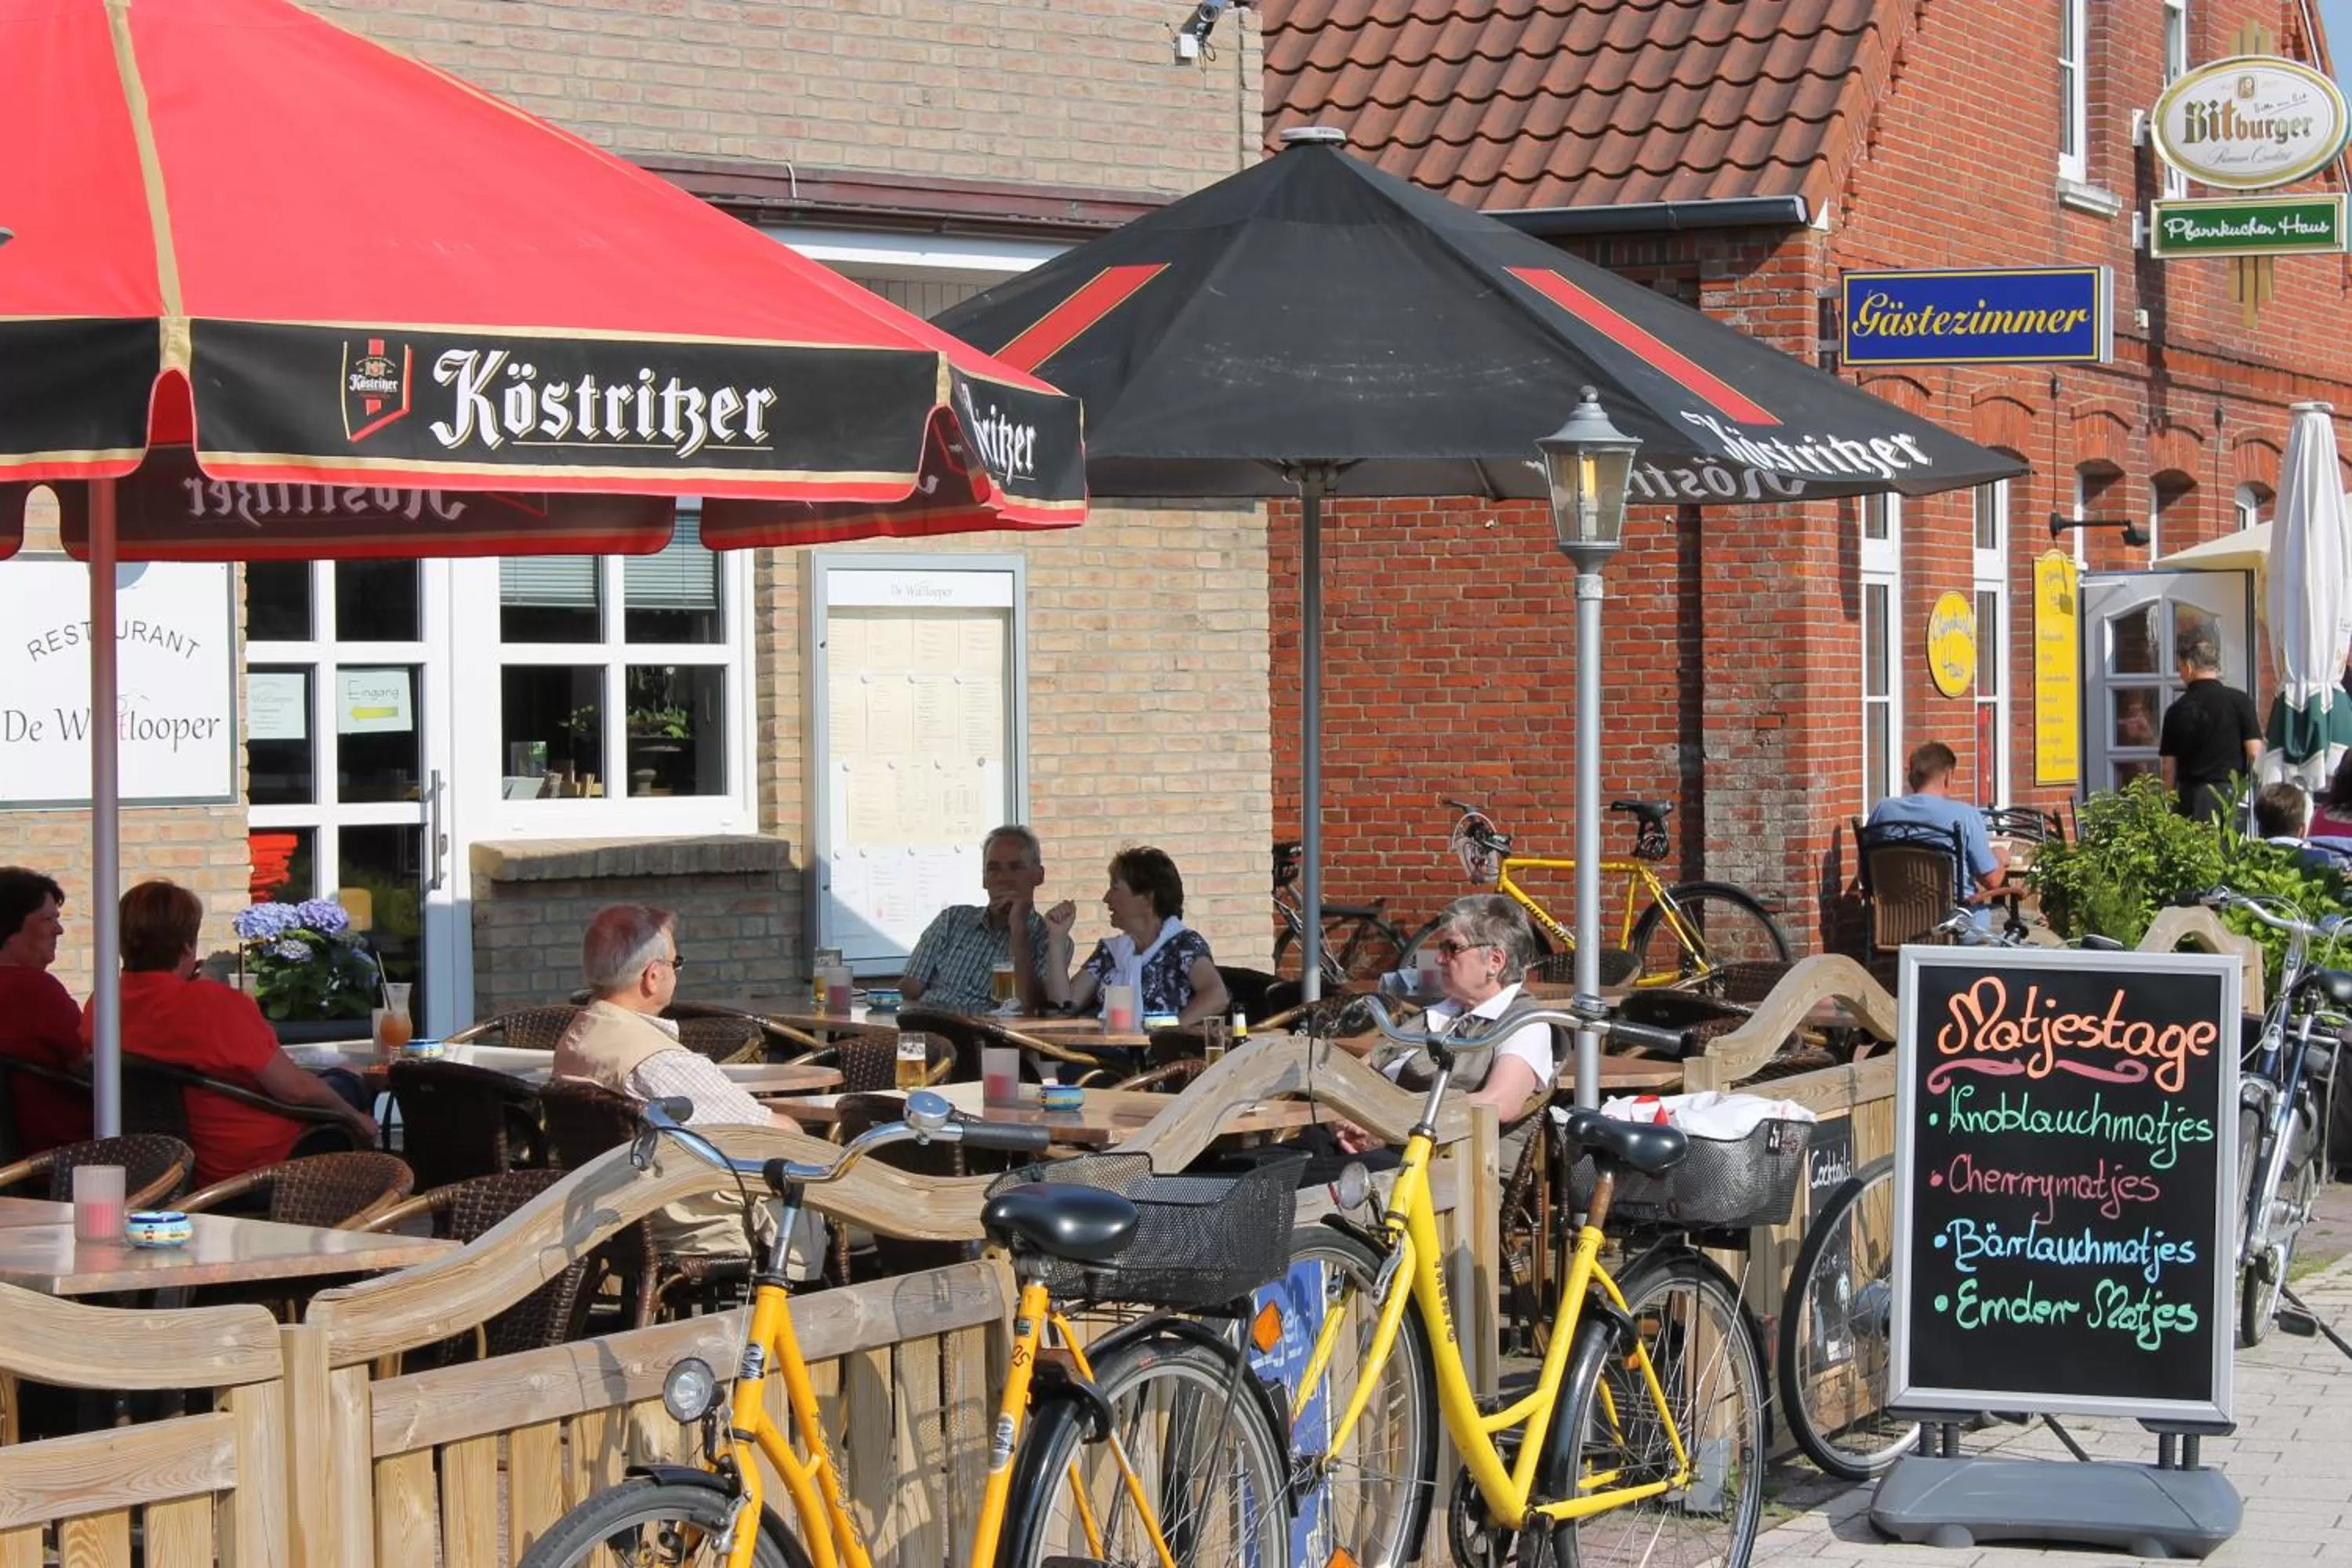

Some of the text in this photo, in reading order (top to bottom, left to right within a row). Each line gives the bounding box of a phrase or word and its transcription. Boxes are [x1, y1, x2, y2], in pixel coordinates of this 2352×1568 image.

[2183, 99, 2314, 144] Bitburger
[2164, 214, 2330, 241] Pfannkuchen Haus
[1852, 289, 2090, 336] Gästezimmer
[429, 349, 778, 459] Köstritzer
[27, 620, 201, 662] RESTURANT
[3, 710, 43, 742] De
[53, 708, 221, 753] Wtlooper
[1937, 976, 2218, 1092] Matjestage
[1948, 1085, 2215, 1169] Knoblauchmatjes
[1948, 1153, 2161, 1225] Cherrymatjes
[1946, 1218, 2197, 1283] Bärlauchmatjes
[1955, 1278, 2198, 1351] Emder Matjes
